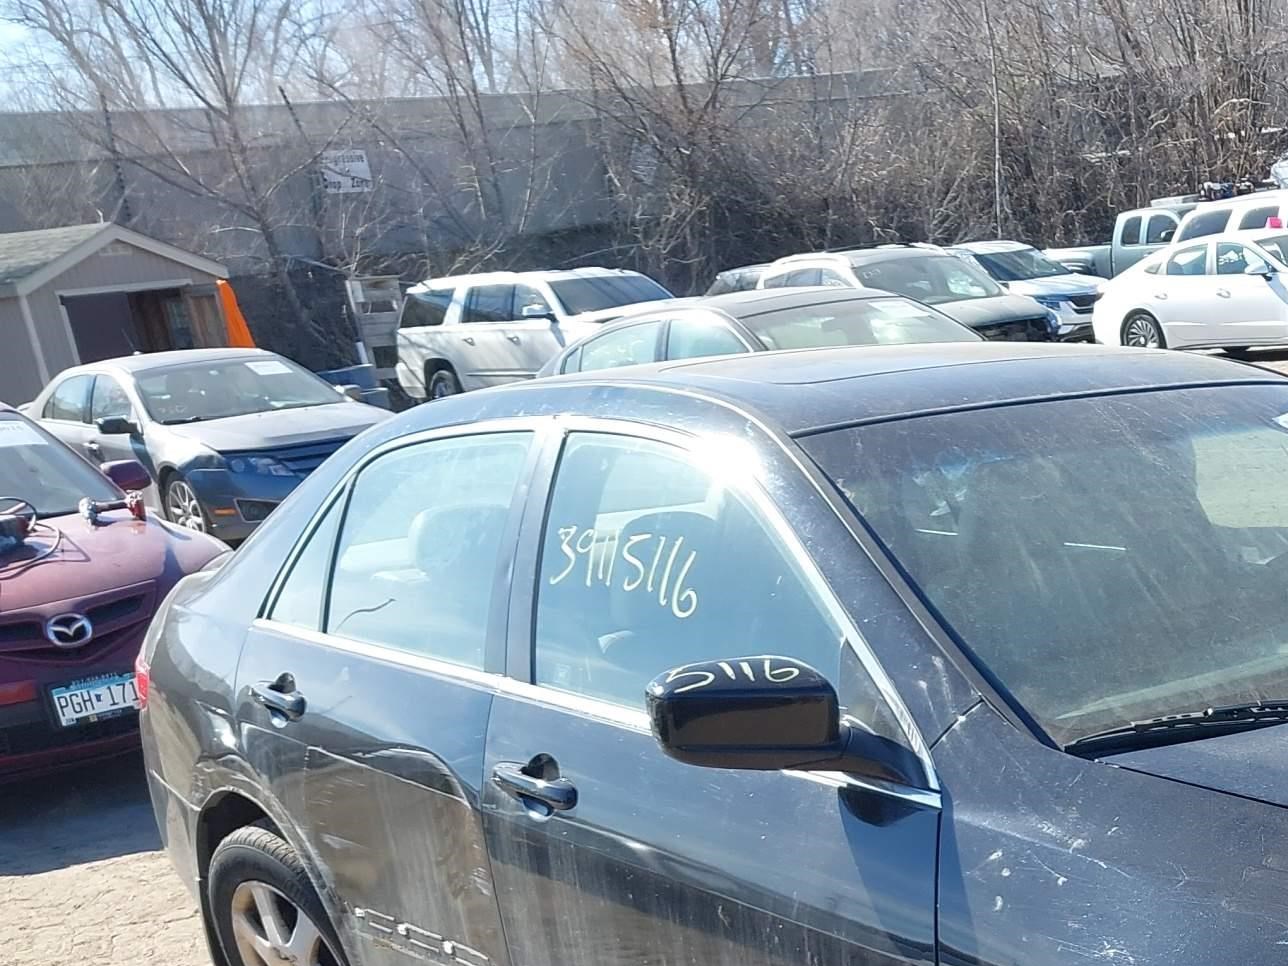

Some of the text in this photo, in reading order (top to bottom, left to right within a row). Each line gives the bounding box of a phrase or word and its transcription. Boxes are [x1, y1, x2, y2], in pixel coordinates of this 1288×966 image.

[550, 525, 697, 618] 39115116
[664, 657, 800, 694] 5116
[56, 690, 95, 717] PGH
[107, 681, 139, 706] 171
